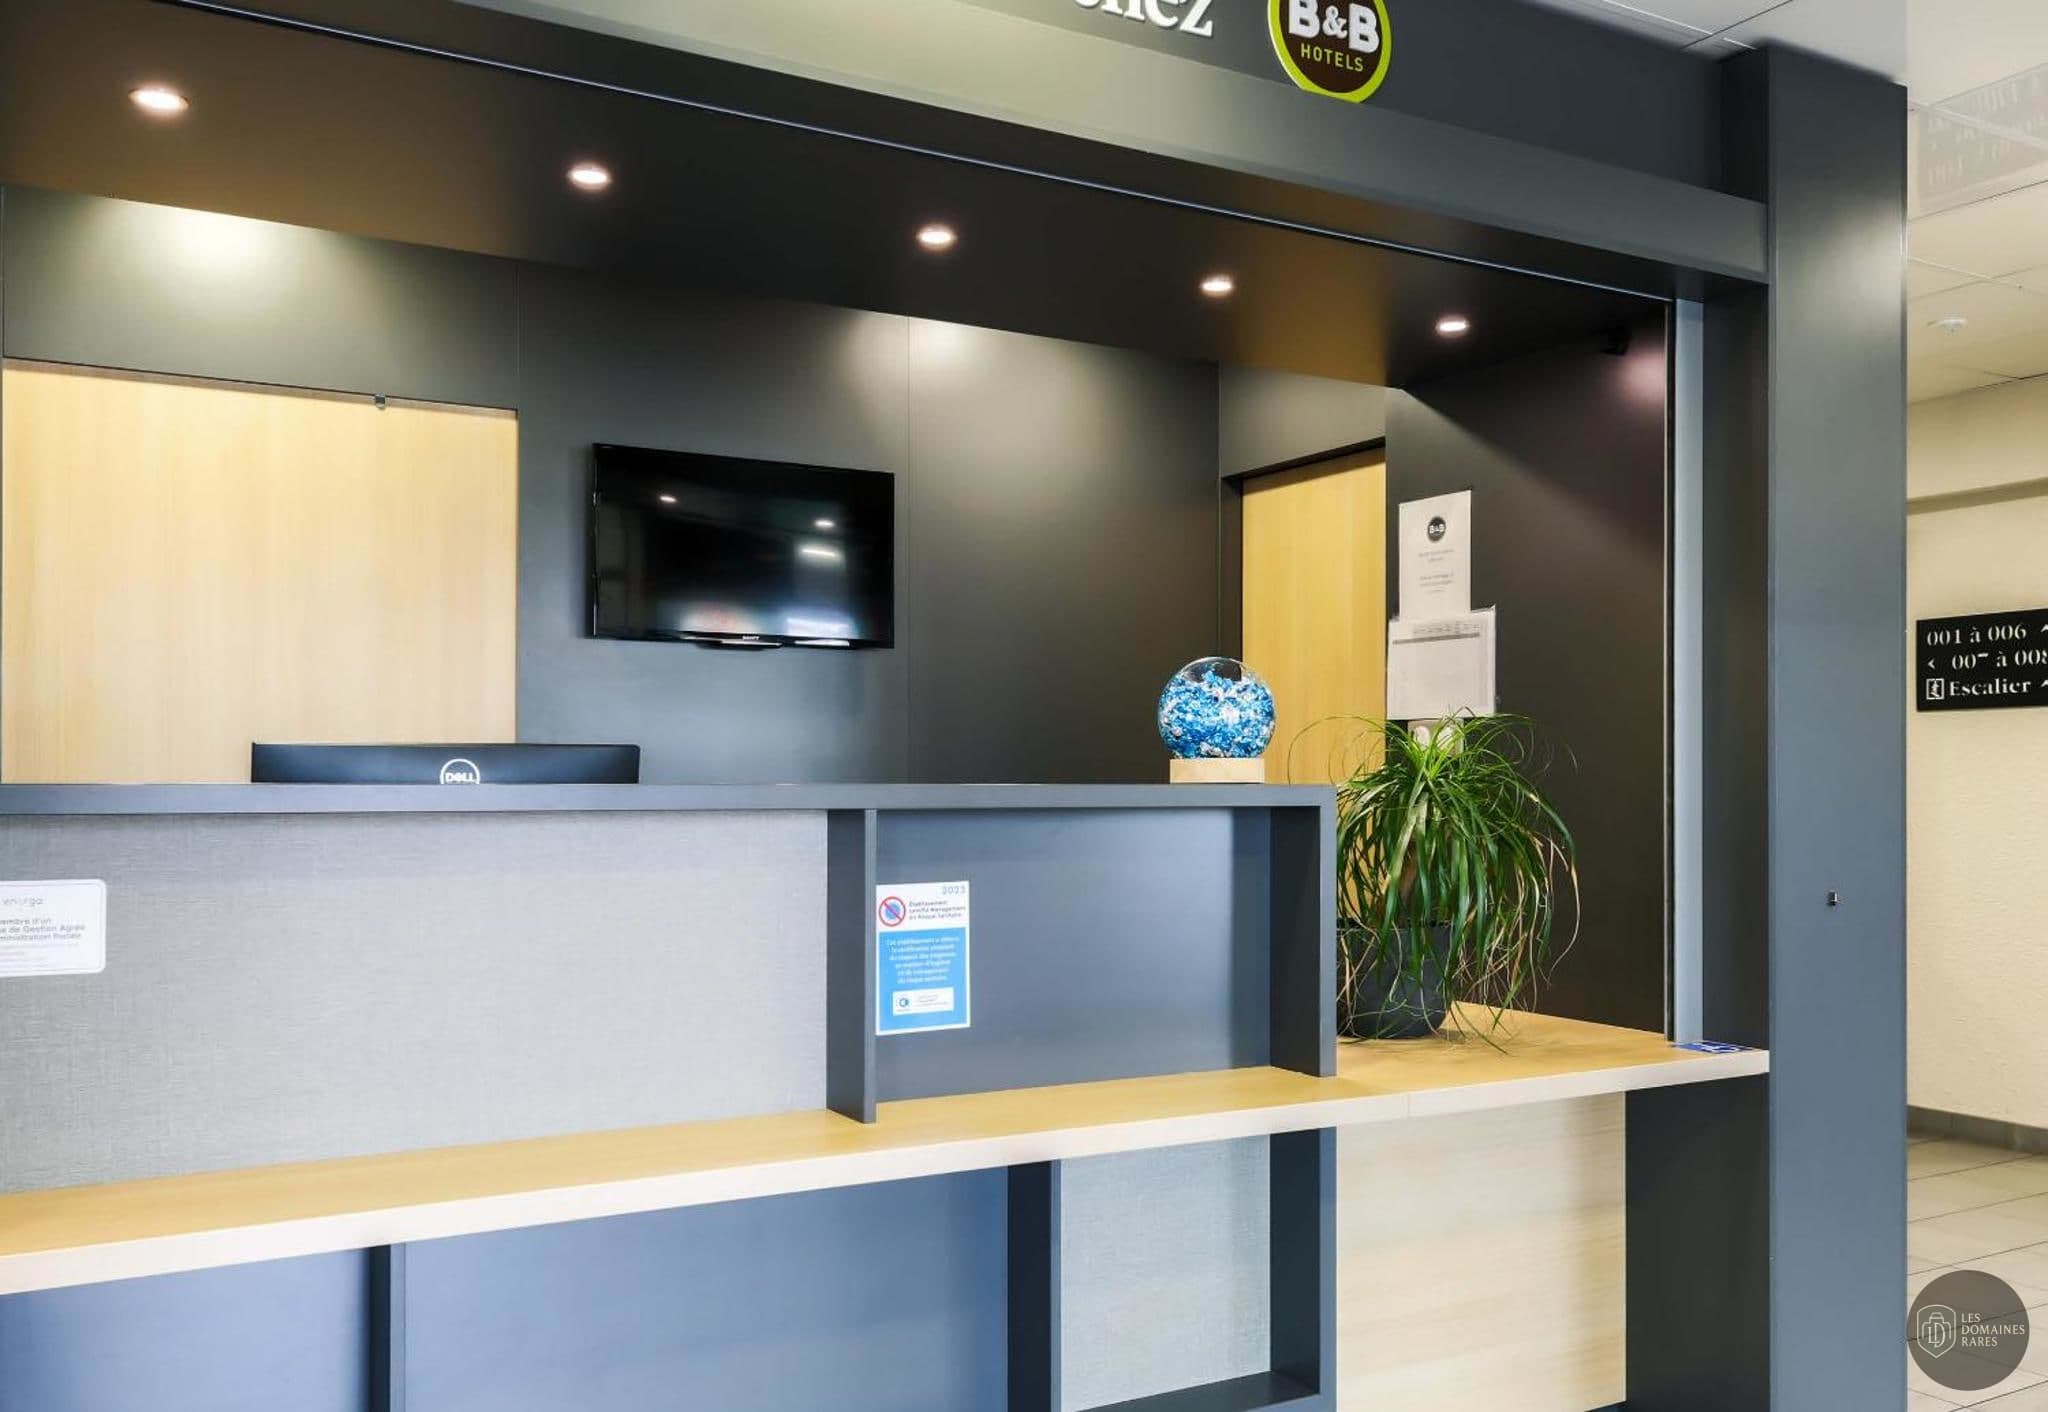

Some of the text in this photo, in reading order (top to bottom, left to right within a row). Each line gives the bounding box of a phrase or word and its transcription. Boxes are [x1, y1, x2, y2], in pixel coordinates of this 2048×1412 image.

[1073, 0, 1213, 38] ez
[1289, 0, 1380, 54] B&B
[1300, 43, 1364, 72] HOTELS
[1927, 623, 2027, 646] 001 à 006
[1996, 651, 2007, 668] à
[1949, 678, 2031, 696] Escalier
[446, 772, 473, 782] DELL
